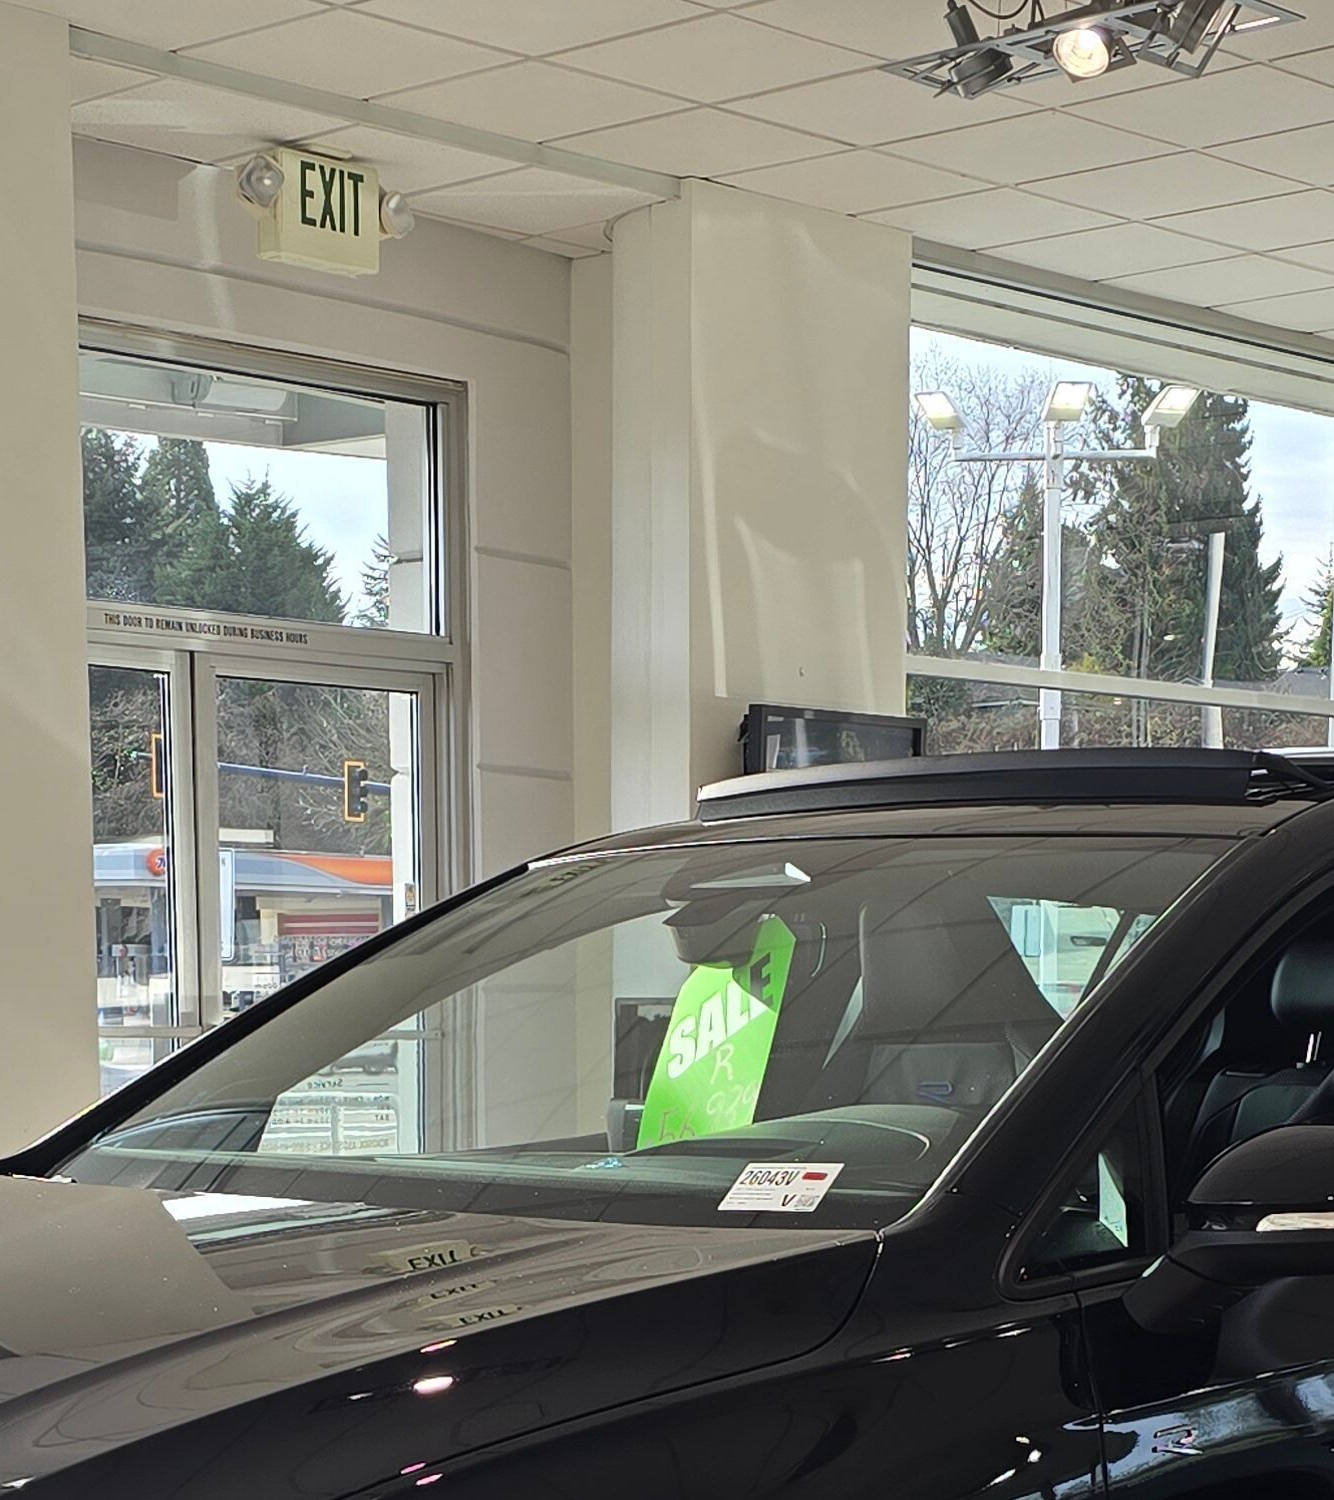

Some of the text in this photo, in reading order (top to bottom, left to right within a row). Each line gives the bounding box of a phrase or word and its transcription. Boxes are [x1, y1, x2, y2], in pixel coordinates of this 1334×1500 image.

[300, 160, 364, 237] EXIT
[104, 612, 308, 645] THIS DOOR TO REMAIN UNLOCKED DURING BUSINESS HOURS
[667, 951, 774, 1079] SALE
[739, 1170, 801, 1186] 26043V
